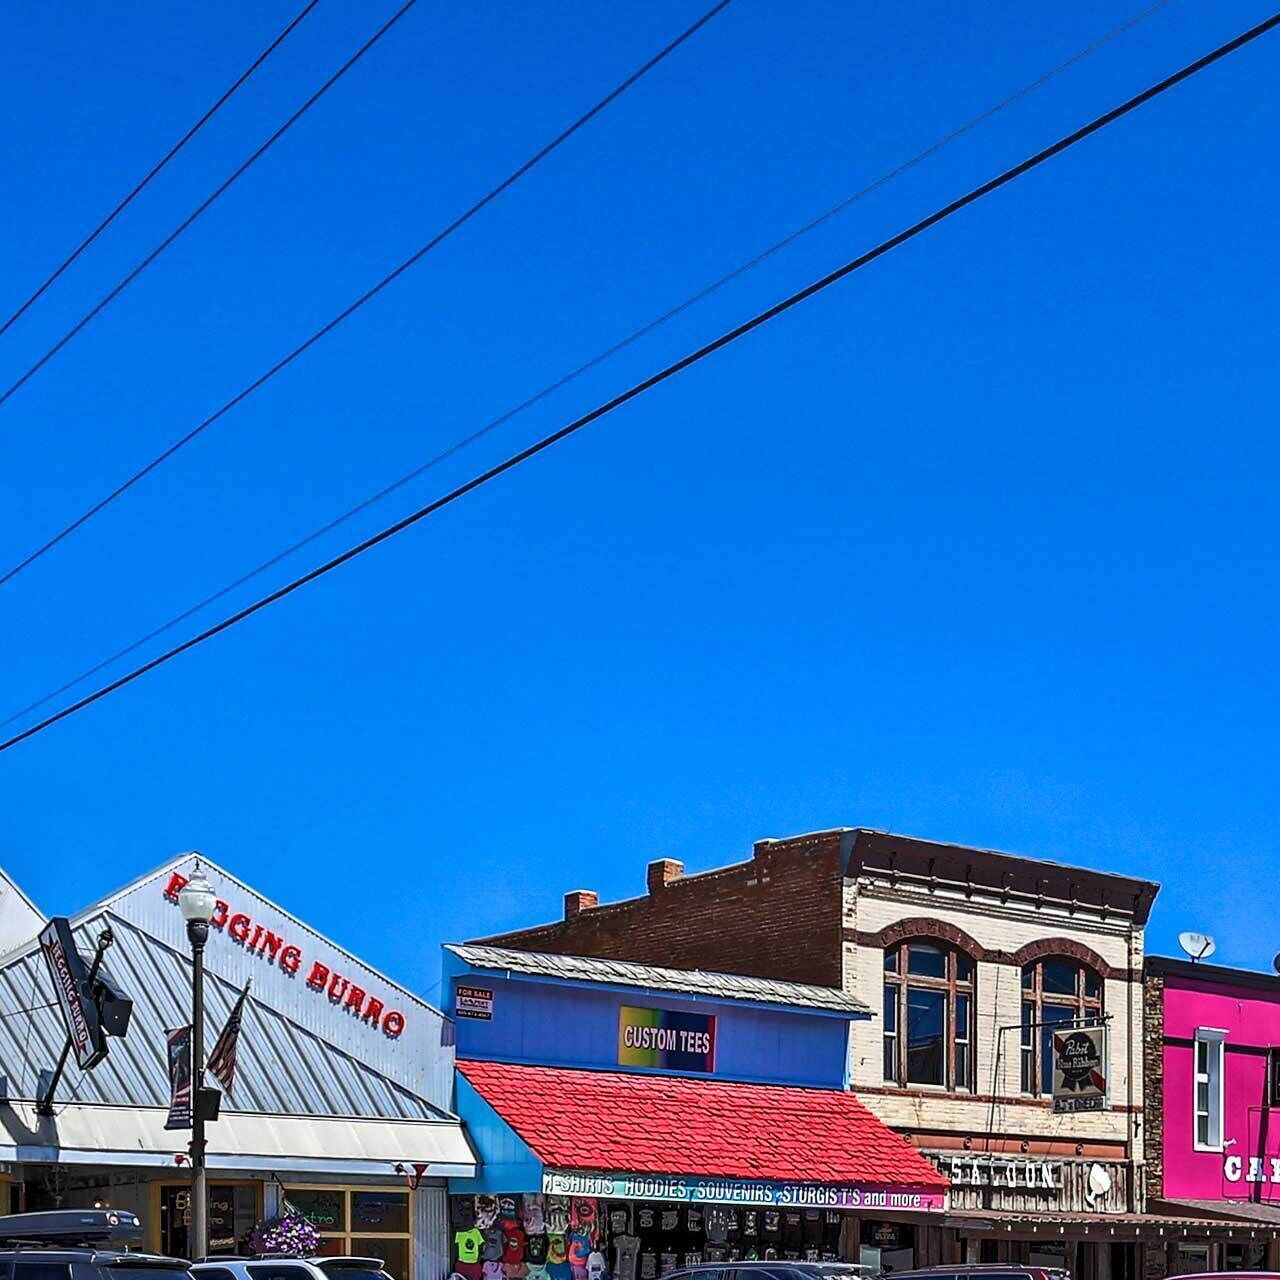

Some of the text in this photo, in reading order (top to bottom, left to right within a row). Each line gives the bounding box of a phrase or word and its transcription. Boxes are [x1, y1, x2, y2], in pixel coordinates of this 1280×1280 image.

[306, 961, 407, 1037] BURRO
[458, 988, 491, 999] FOR SALE
[624, 1025, 710, 1054] CUSTOM TEES
[1065, 1039, 1090, 1056] Pabst
[624, 1177, 687, 1198] HOODIES
[698, 1182, 773, 1202] SOUVENIRS
[782, 1185, 838, 1205] STURGIS
[863, 1191, 887, 1206] and
[890, 1193, 921, 1208] more
